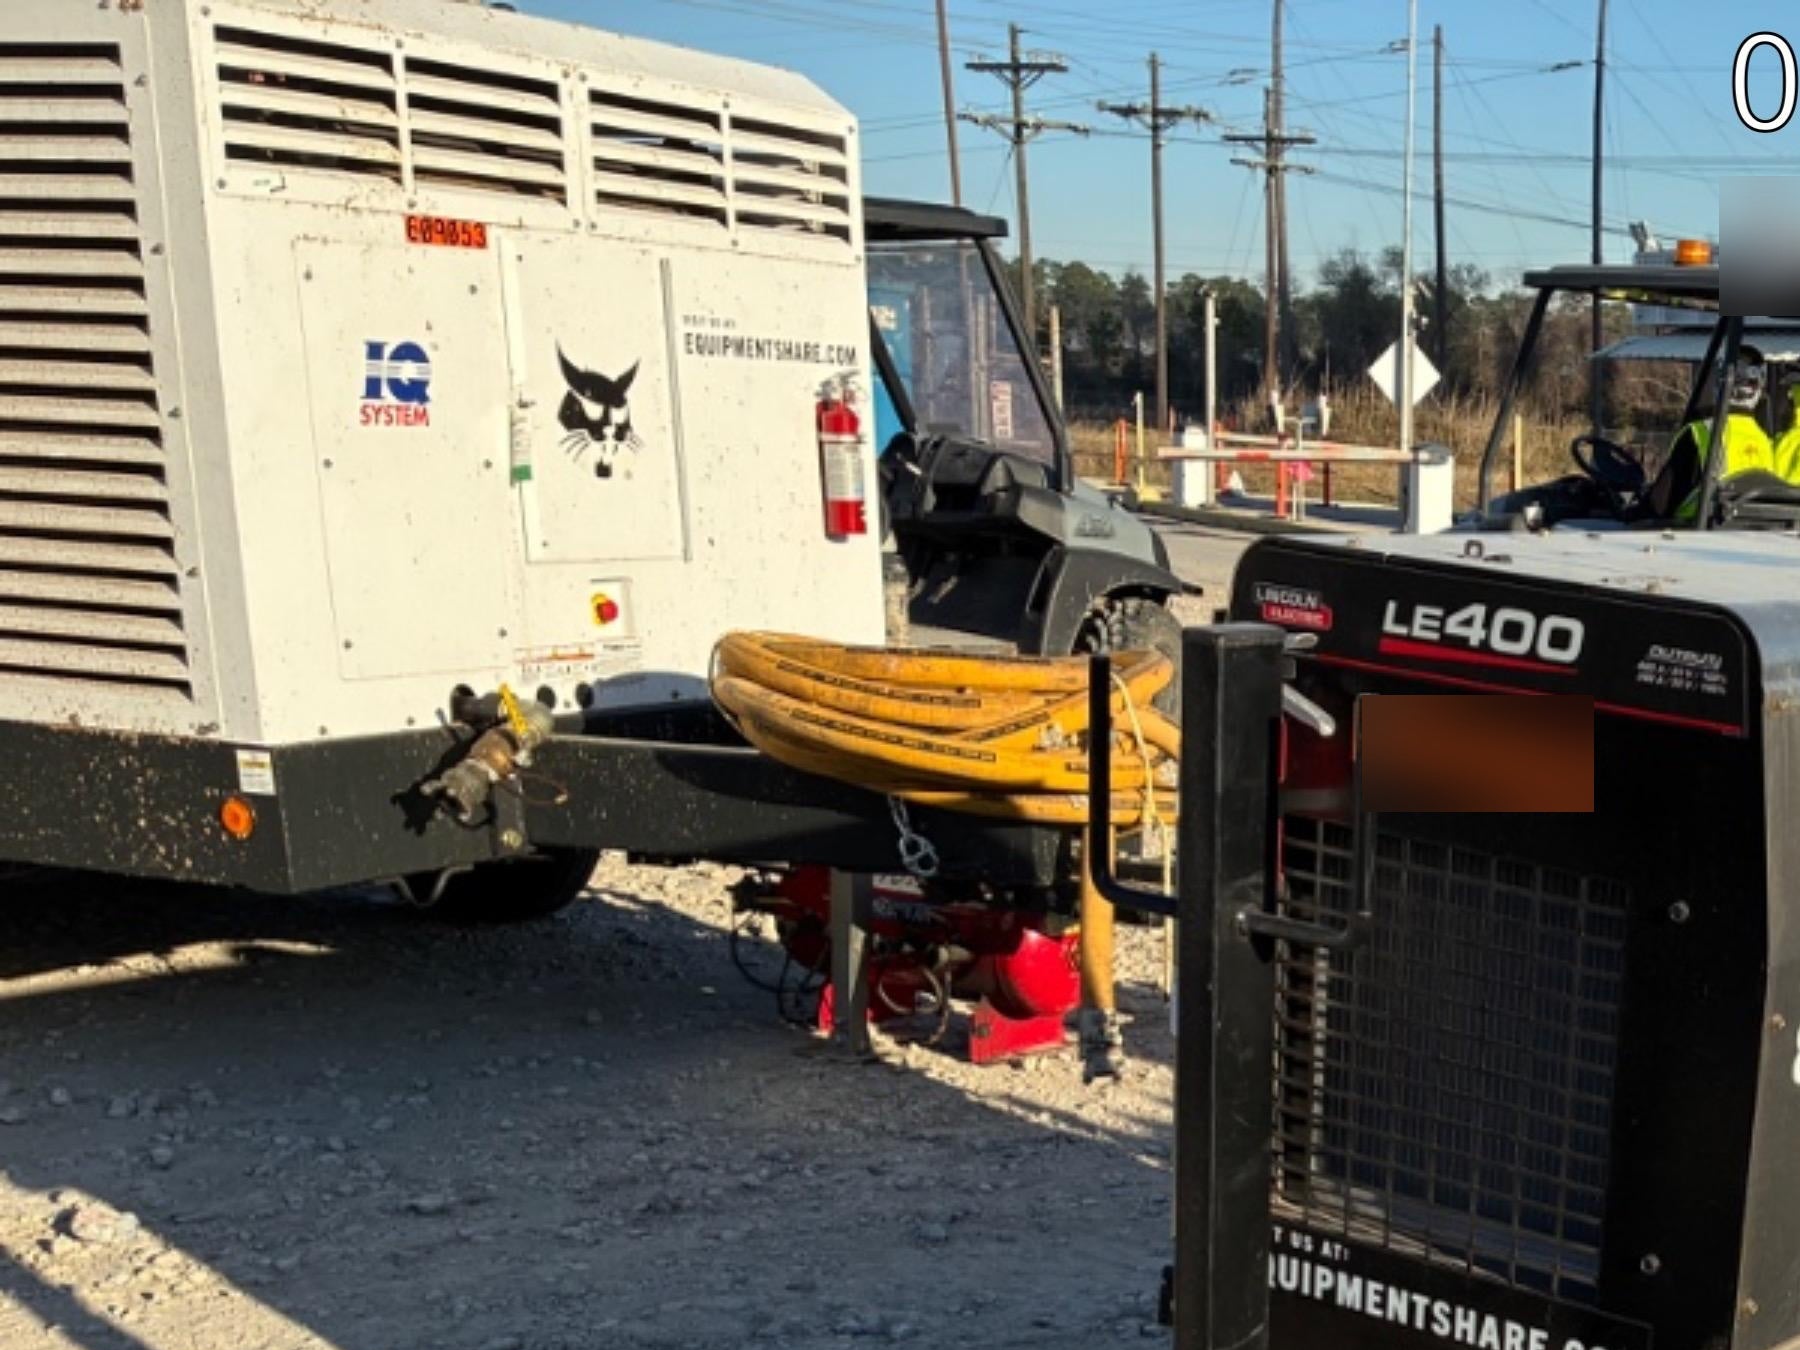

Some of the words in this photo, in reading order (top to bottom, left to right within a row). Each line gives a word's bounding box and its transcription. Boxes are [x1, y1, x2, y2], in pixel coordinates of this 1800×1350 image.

[684, 332, 858, 366] EQUIPMENTSHARE.COM
[359, 404, 429, 427] SYSTEM
[1382, 599, 1585, 664] LE400
[1289, 1230, 1313, 1253] US
